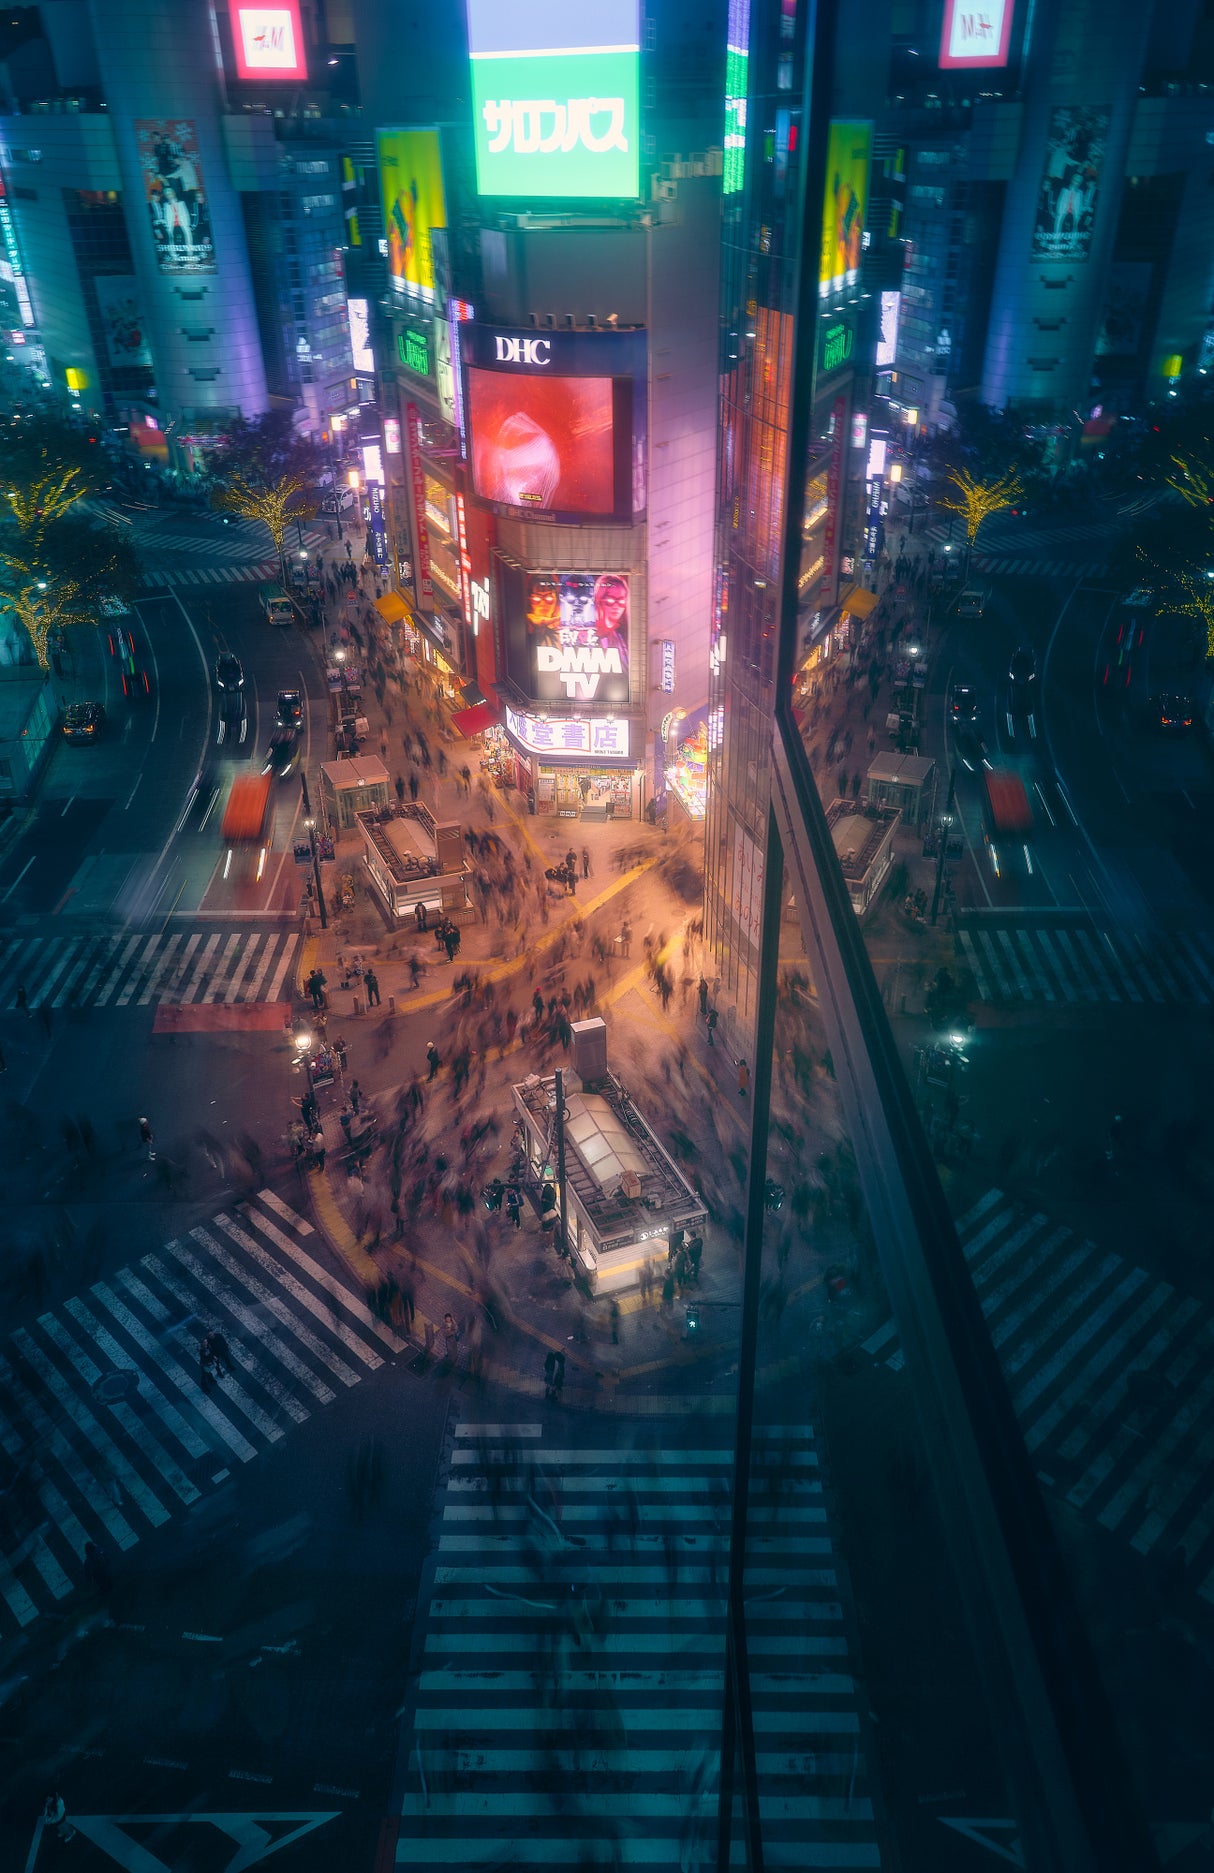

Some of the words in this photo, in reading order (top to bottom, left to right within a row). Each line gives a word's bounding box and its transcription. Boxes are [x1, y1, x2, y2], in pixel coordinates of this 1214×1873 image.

[483, 97, 629, 153] サロンパス
[496, 336, 551, 365] DHC
[371, 487, 380, 513] MIZUHO
[536, 646, 622, 673] DMM
[559, 673, 600, 698] TV
